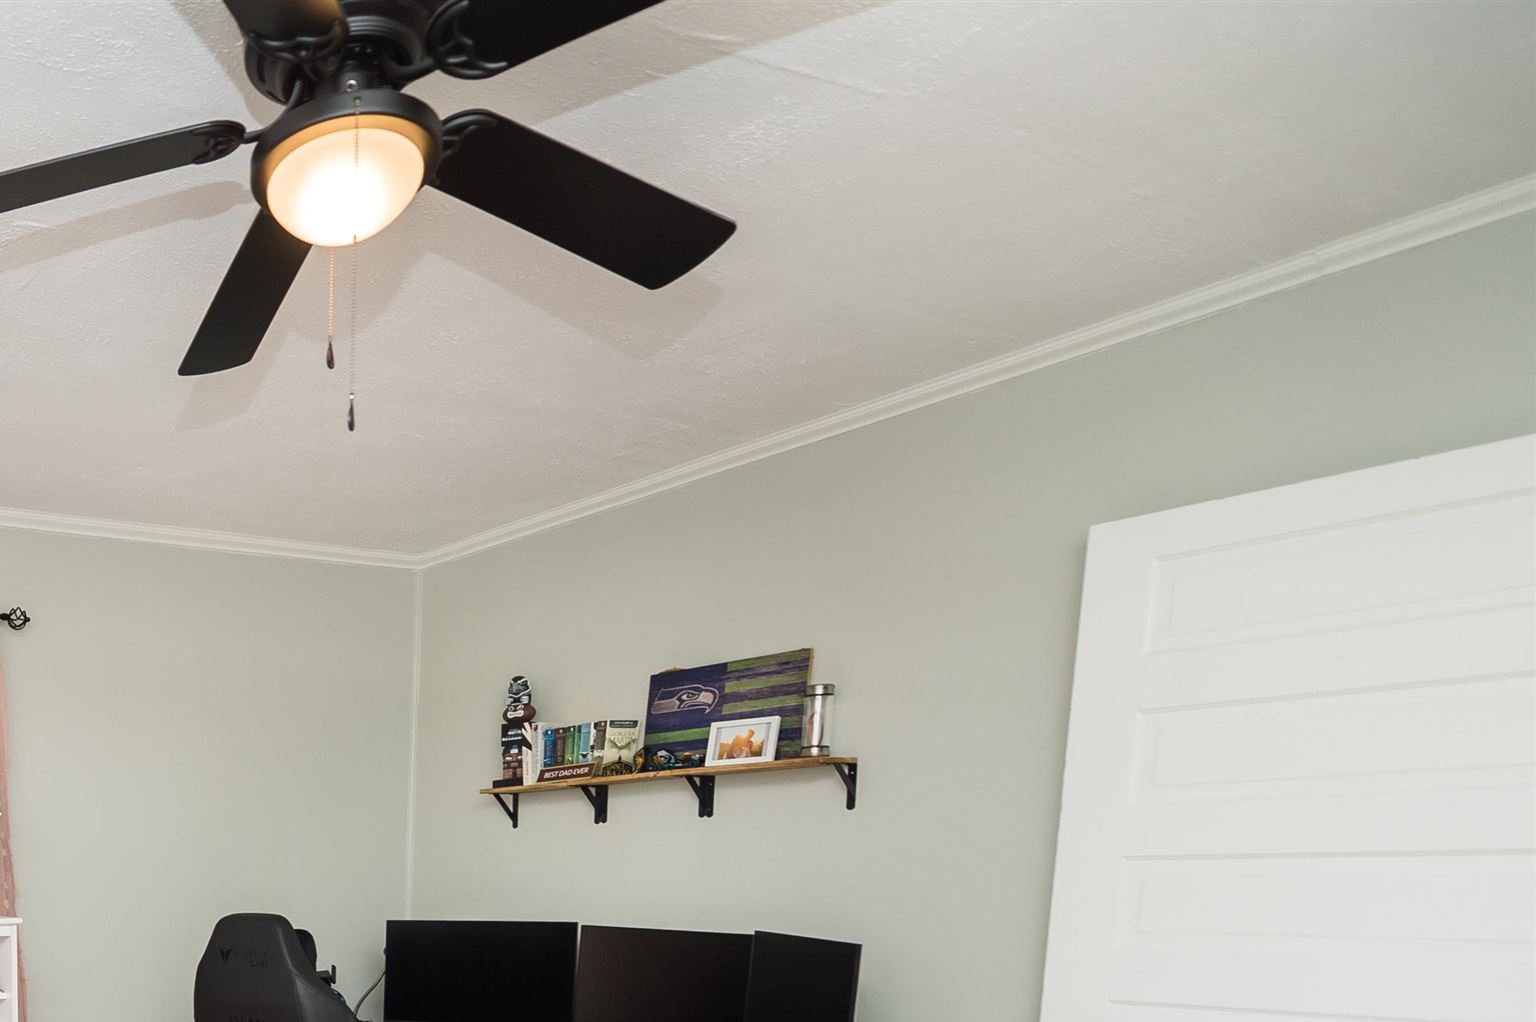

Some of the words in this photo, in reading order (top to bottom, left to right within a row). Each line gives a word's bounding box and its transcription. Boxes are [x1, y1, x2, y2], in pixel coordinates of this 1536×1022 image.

[544, 770, 560, 779] BEST
[559, 768, 573, 777] DAD
[573, 766, 589, 775] EVER
